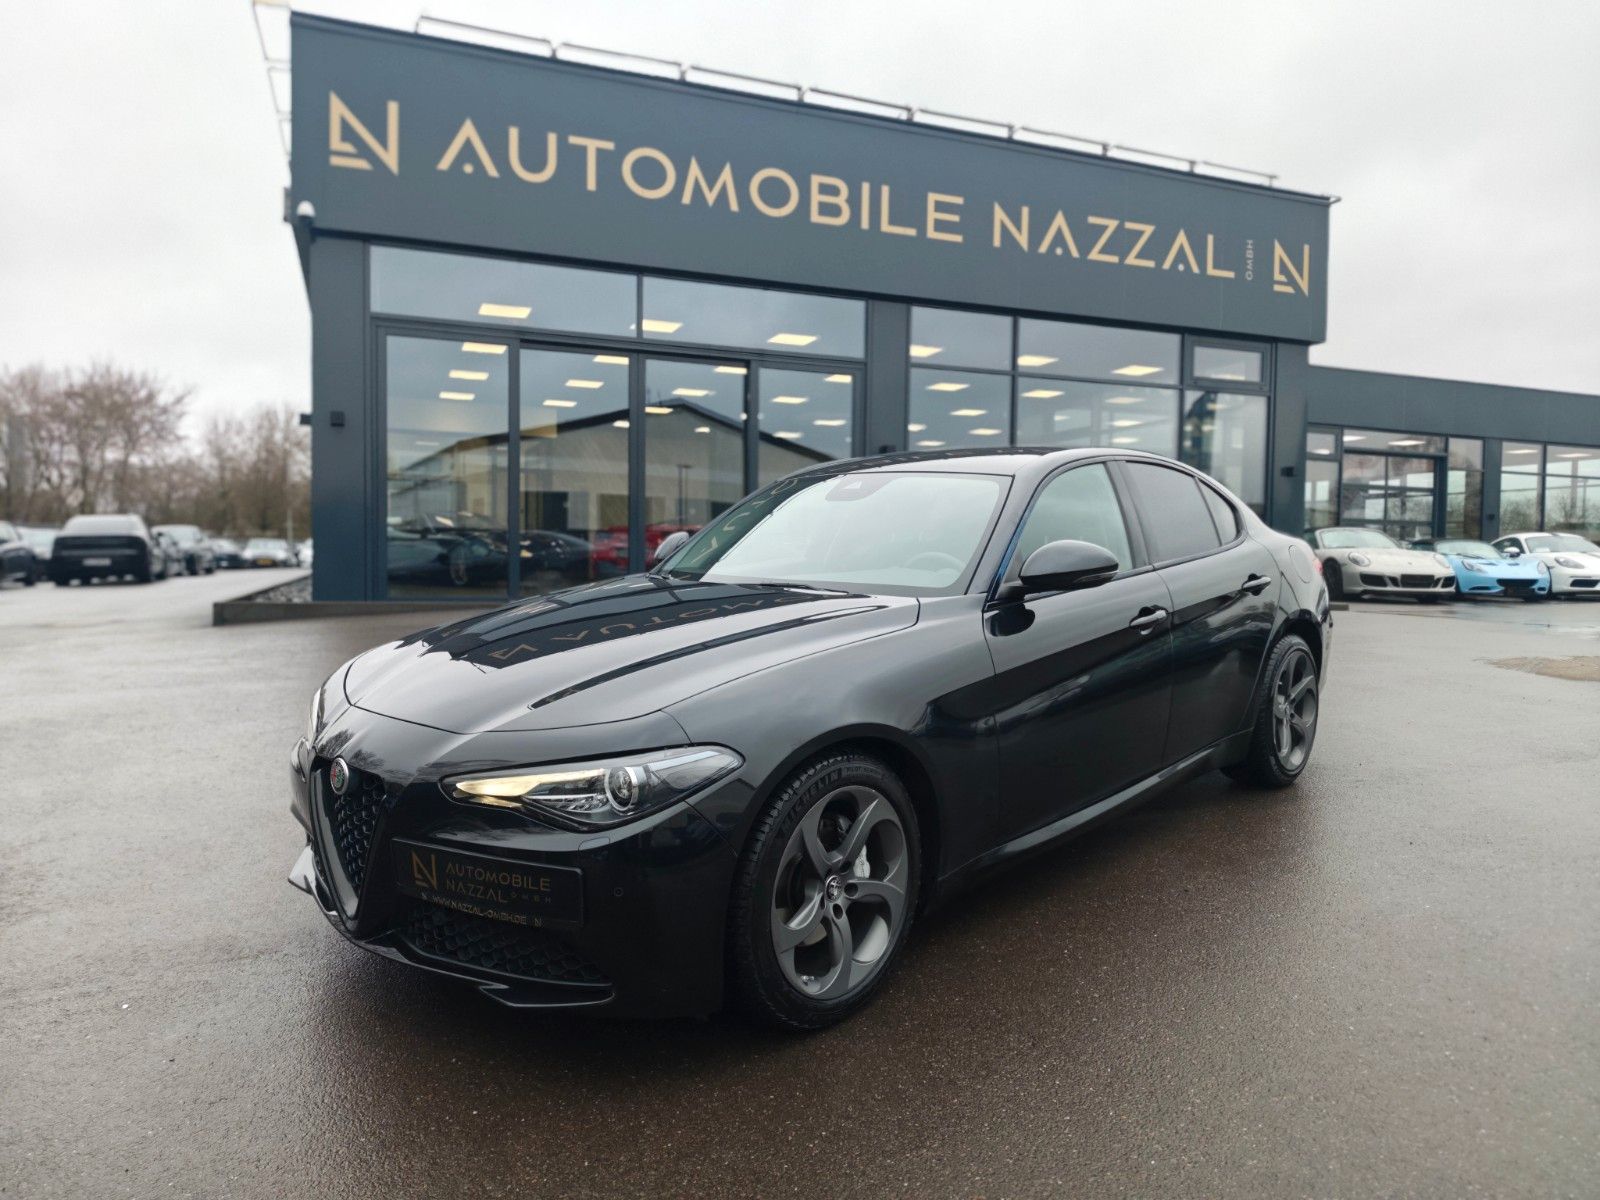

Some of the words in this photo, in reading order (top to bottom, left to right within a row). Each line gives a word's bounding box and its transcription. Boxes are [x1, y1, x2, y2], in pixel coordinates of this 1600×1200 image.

[437, 118, 965, 244] AUTOMOBILE
[993, 202, 1236, 279] NAZZAL
[446, 863, 551, 891] AUTOMOBILE
[446, 880, 508, 903] NAZZAL
